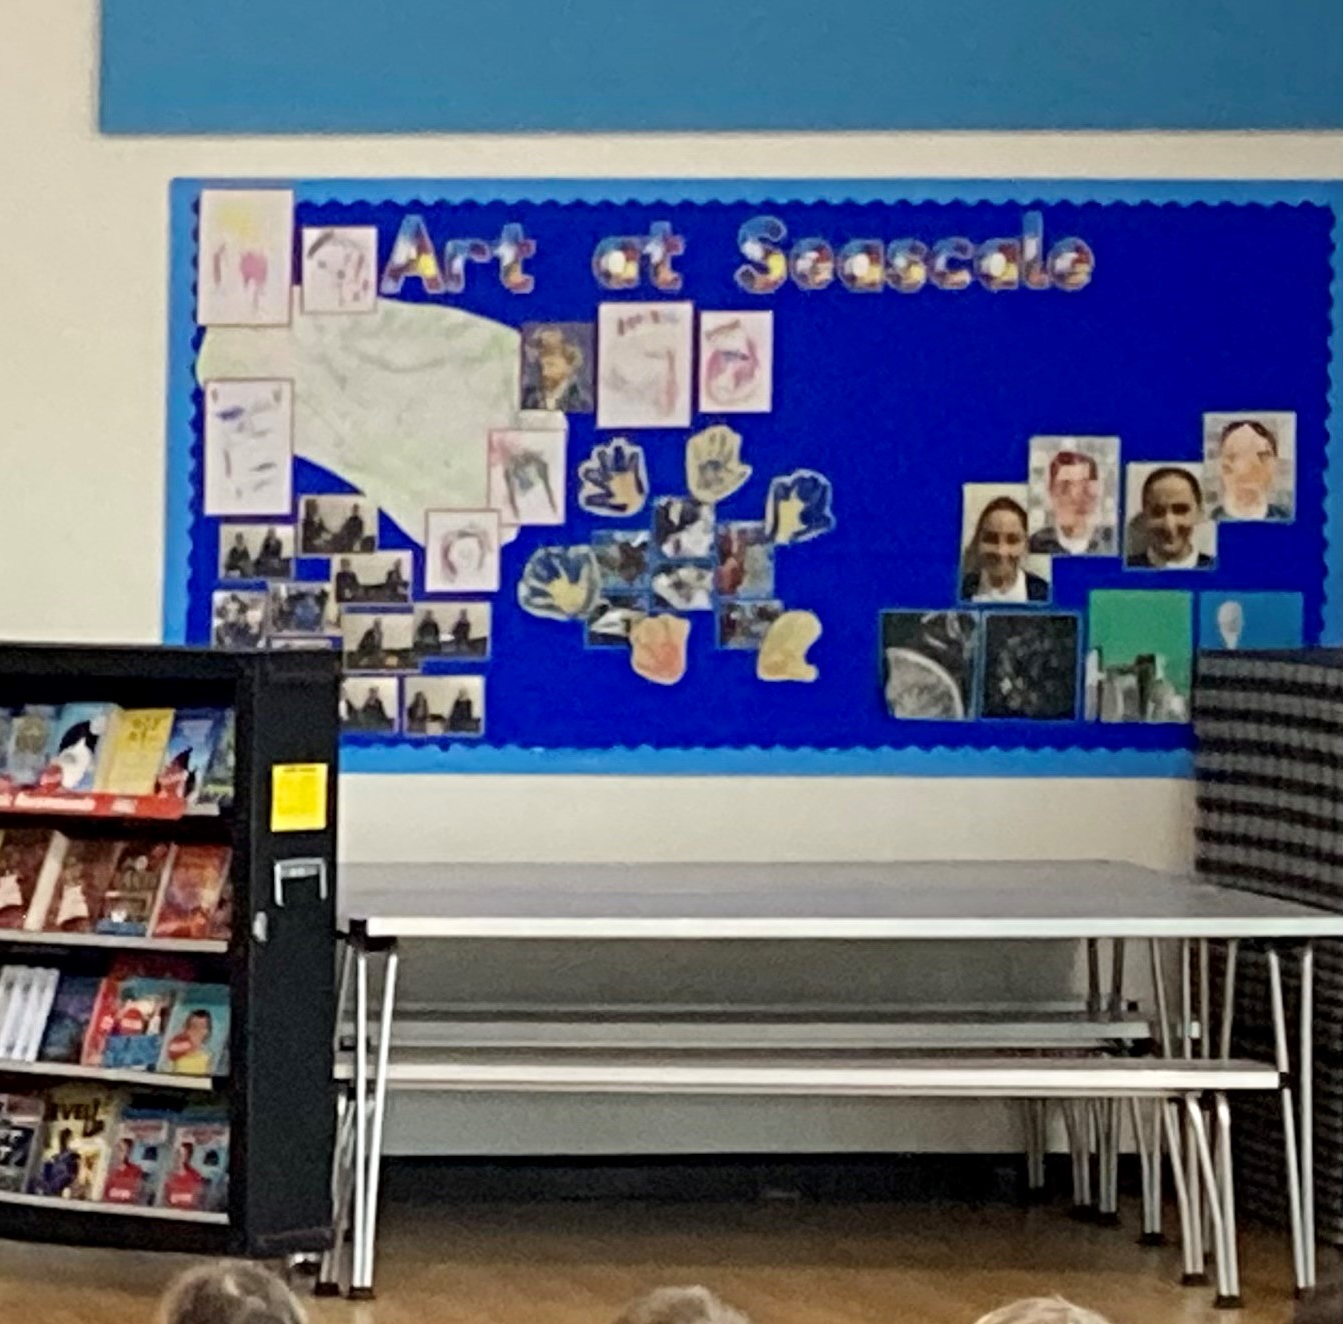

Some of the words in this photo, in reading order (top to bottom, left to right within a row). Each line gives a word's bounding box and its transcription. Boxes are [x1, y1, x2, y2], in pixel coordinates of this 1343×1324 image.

[381, 213, 538, 295] Art
[593, 219, 685, 292] at
[734, 210, 1095, 294] Seascale
